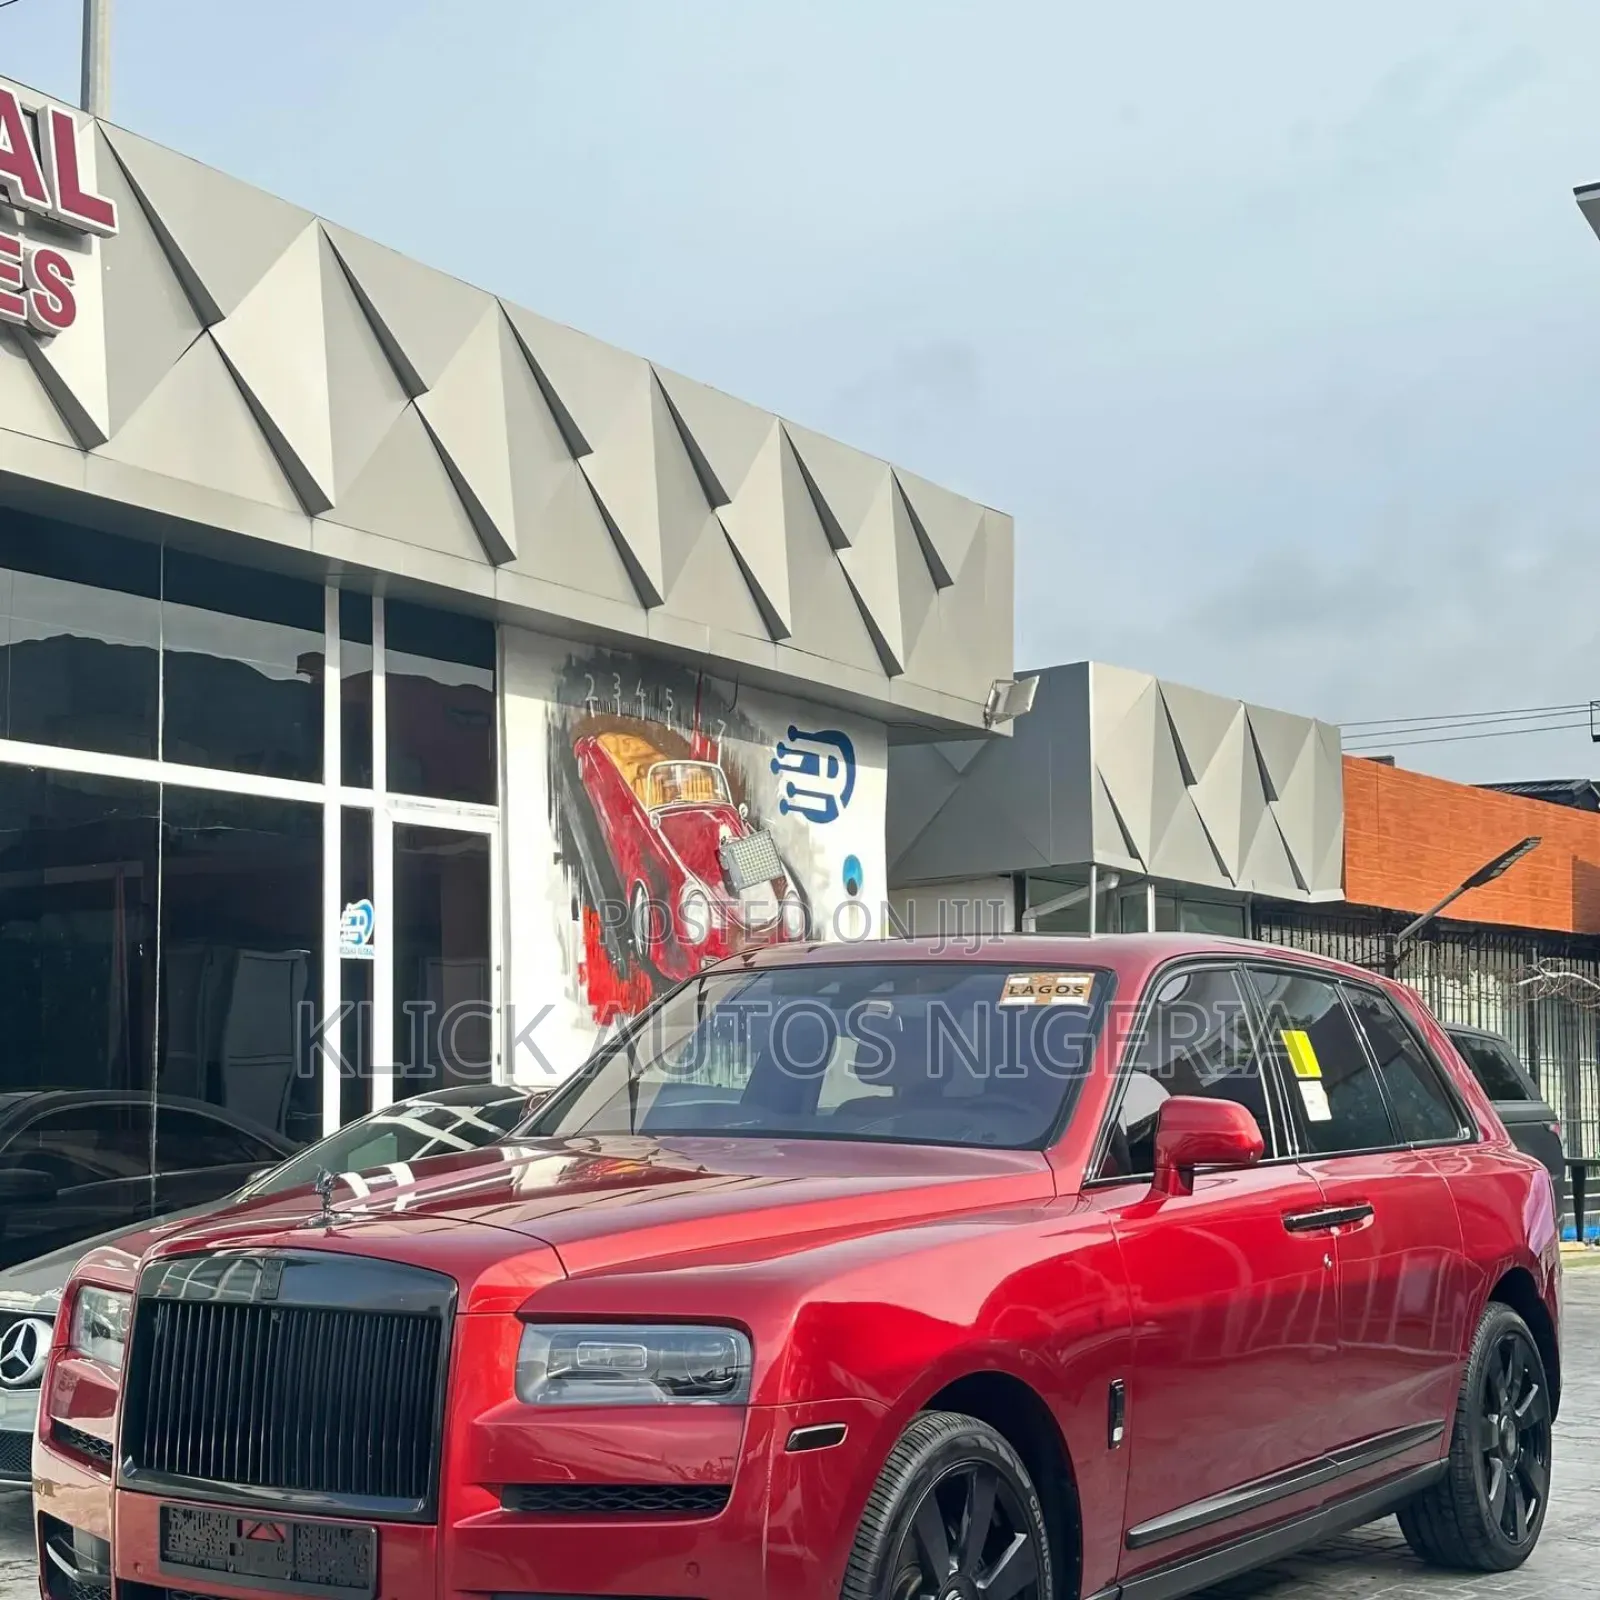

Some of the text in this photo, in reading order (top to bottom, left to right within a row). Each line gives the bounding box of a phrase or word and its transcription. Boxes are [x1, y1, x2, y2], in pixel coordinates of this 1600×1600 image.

[584, 673, 599, 701] 2
[612, 672, 621, 698] 3
[635, 678, 647, 698] 4
[665, 687, 674, 711] 5
[1008, 984, 1085, 995] LAGOS
